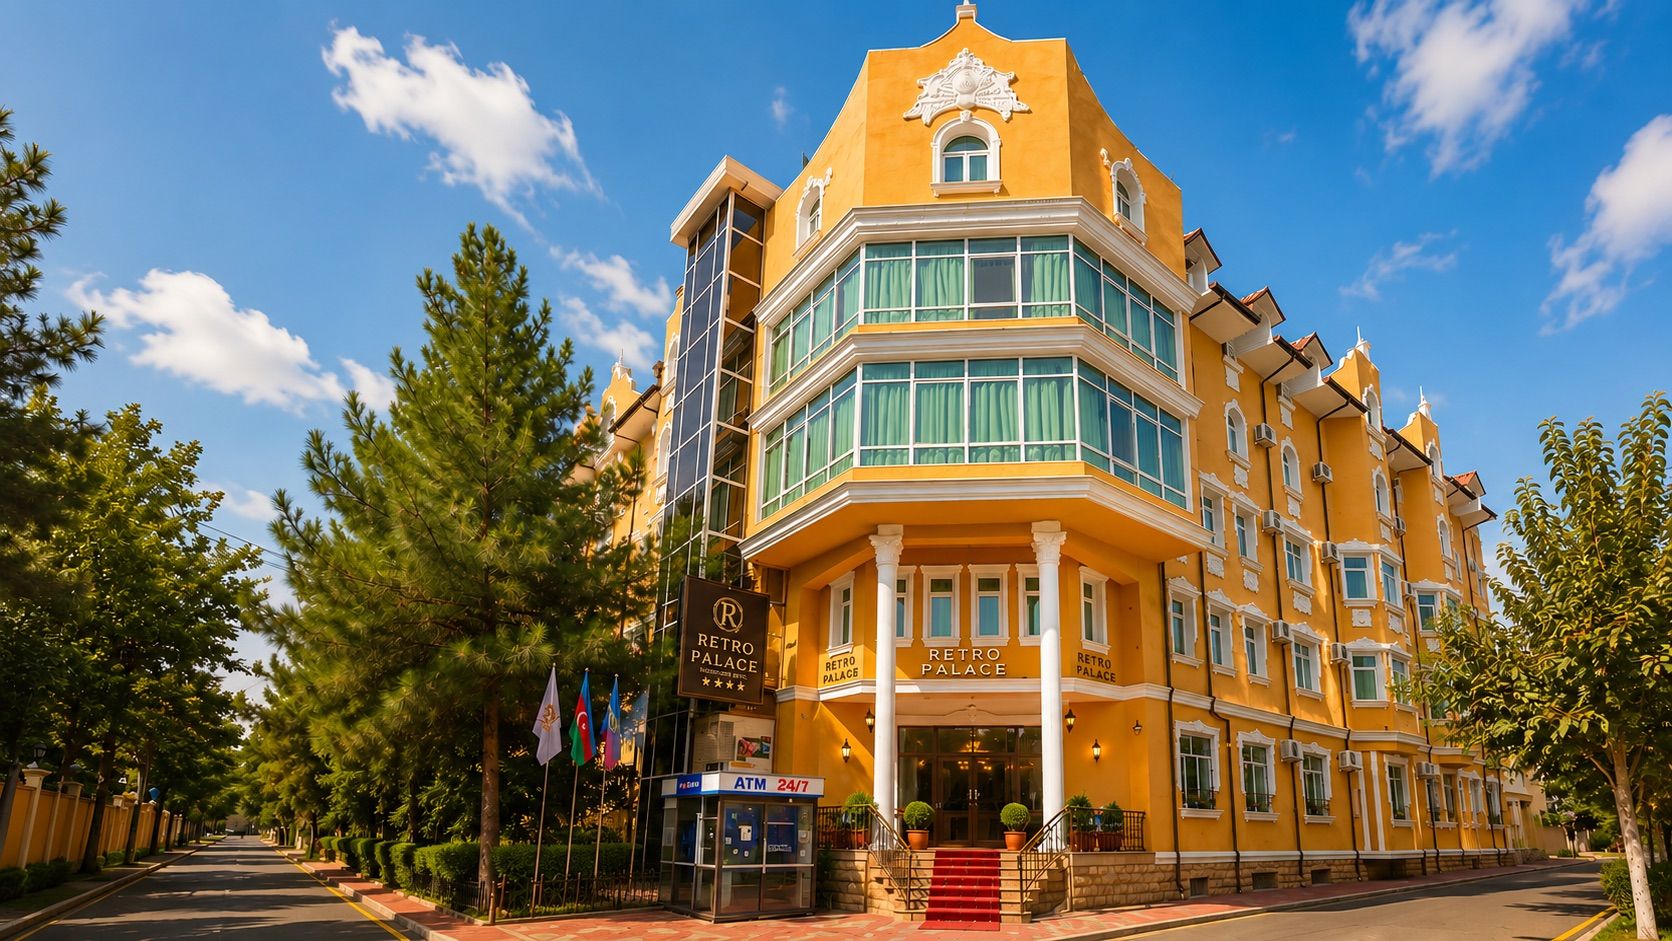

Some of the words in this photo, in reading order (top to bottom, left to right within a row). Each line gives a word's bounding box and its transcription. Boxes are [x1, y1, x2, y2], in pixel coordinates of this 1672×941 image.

[698, 633, 754, 655] RETRO
[691, 650, 758, 673] PALACE
[928, 648, 1000, 660] RETRO
[1077, 652, 1112, 669] RETRO
[825, 656, 855, 671] RETRO
[921, 663, 1006, 675] PALACE
[823, 667, 858, 684] PALACE
[1076, 665, 1116, 683] PALACE
[734, 776, 766, 790] ATM
[777, 778, 809, 792] 24/7
